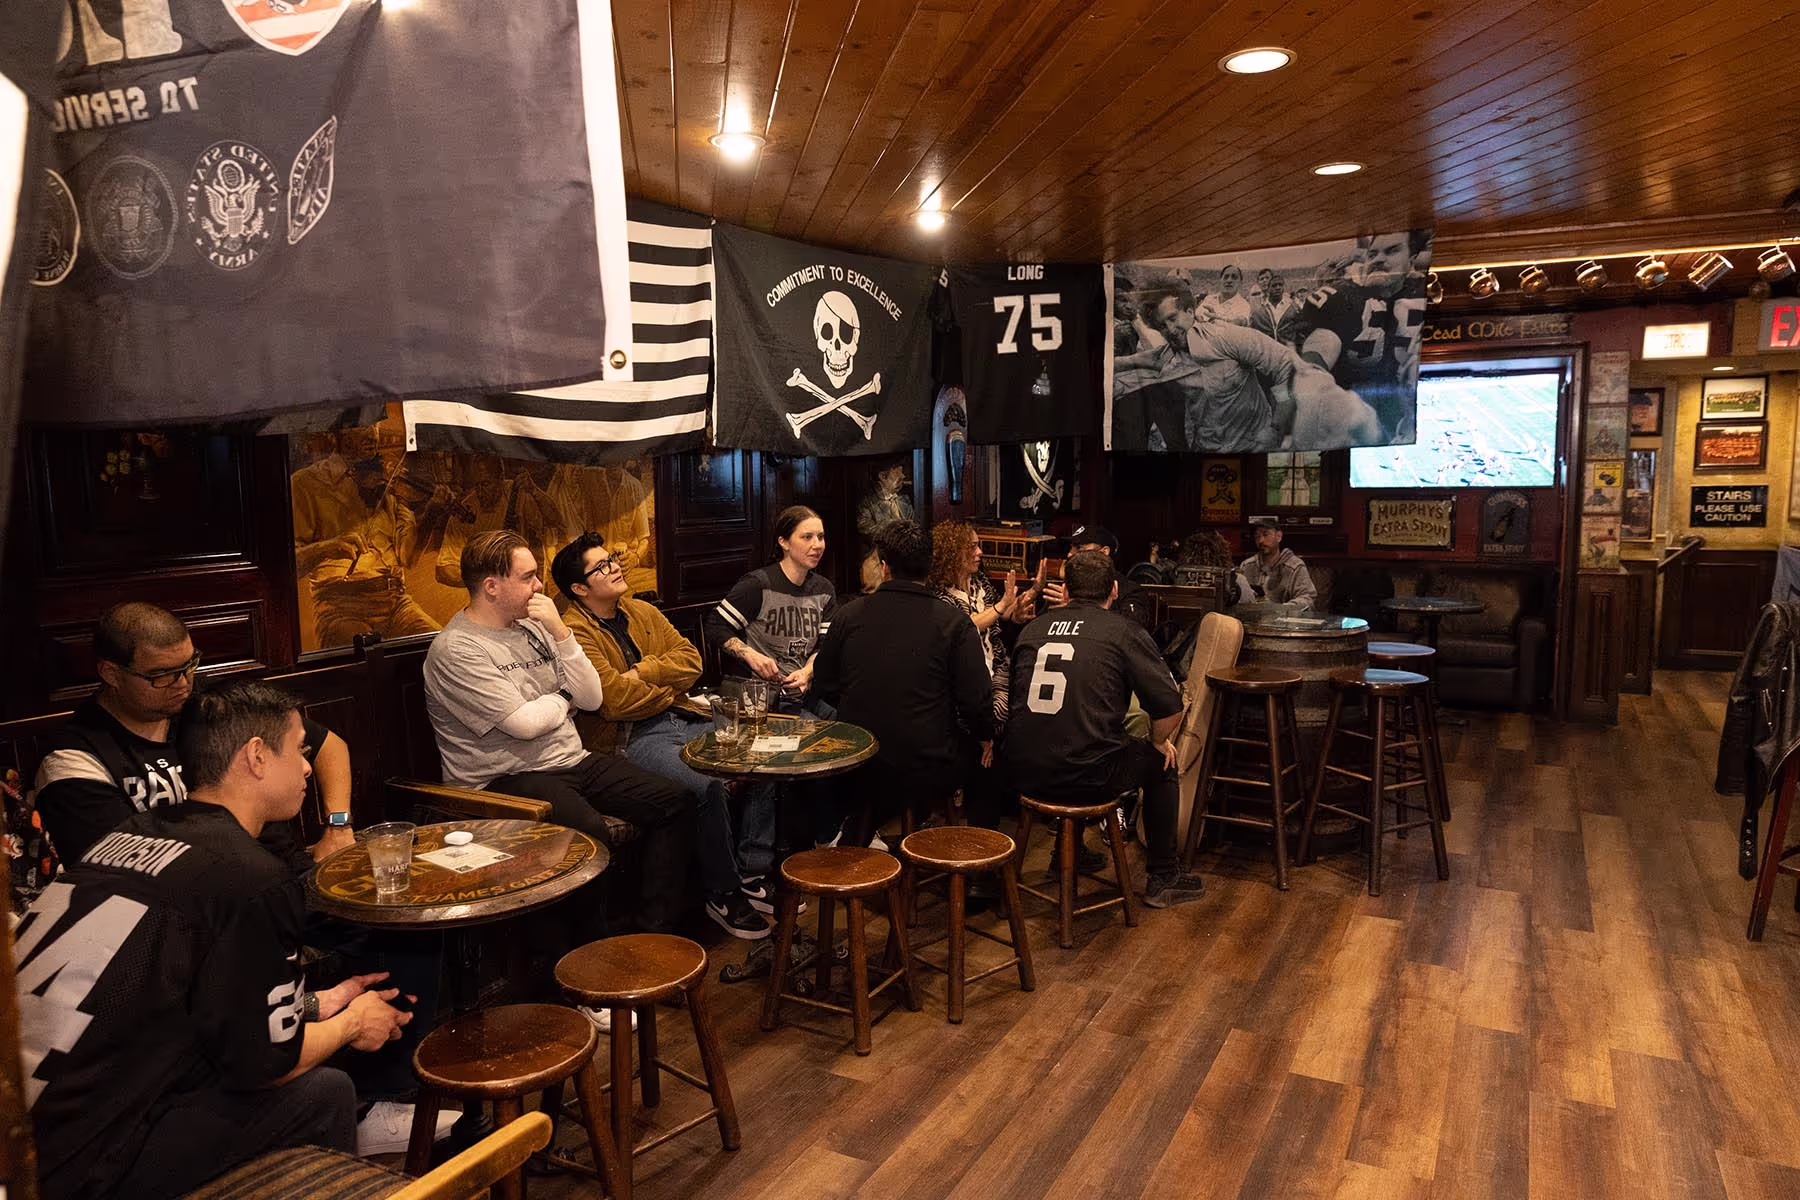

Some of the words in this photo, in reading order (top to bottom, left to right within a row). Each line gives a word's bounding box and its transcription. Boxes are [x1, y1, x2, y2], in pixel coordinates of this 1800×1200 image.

[1007, 264, 1045, 281] LONG
[766, 264, 825, 308] COMMITMENT
[829, 266, 844, 281] TO
[847, 269, 902, 321] EXCELLENCE
[993, 293, 1063, 354] 75
[1694, 504, 1735, 513] PLEASE
[1740, 504, 1762, 513] USE
[1706, 490, 1752, 501] STAIRS
[1373, 521, 1409, 536] EXTRA
[1412, 518, 1449, 538] STOUT
[1704, 513, 1752, 522] CAUTION
[765, 606, 821, 638] RAIDER
[1047, 620, 1085, 637] COLE
[1026, 642, 1075, 715] 6
[122, 765, 188, 813] RAI
[80, 831, 192, 878] WOODSON
